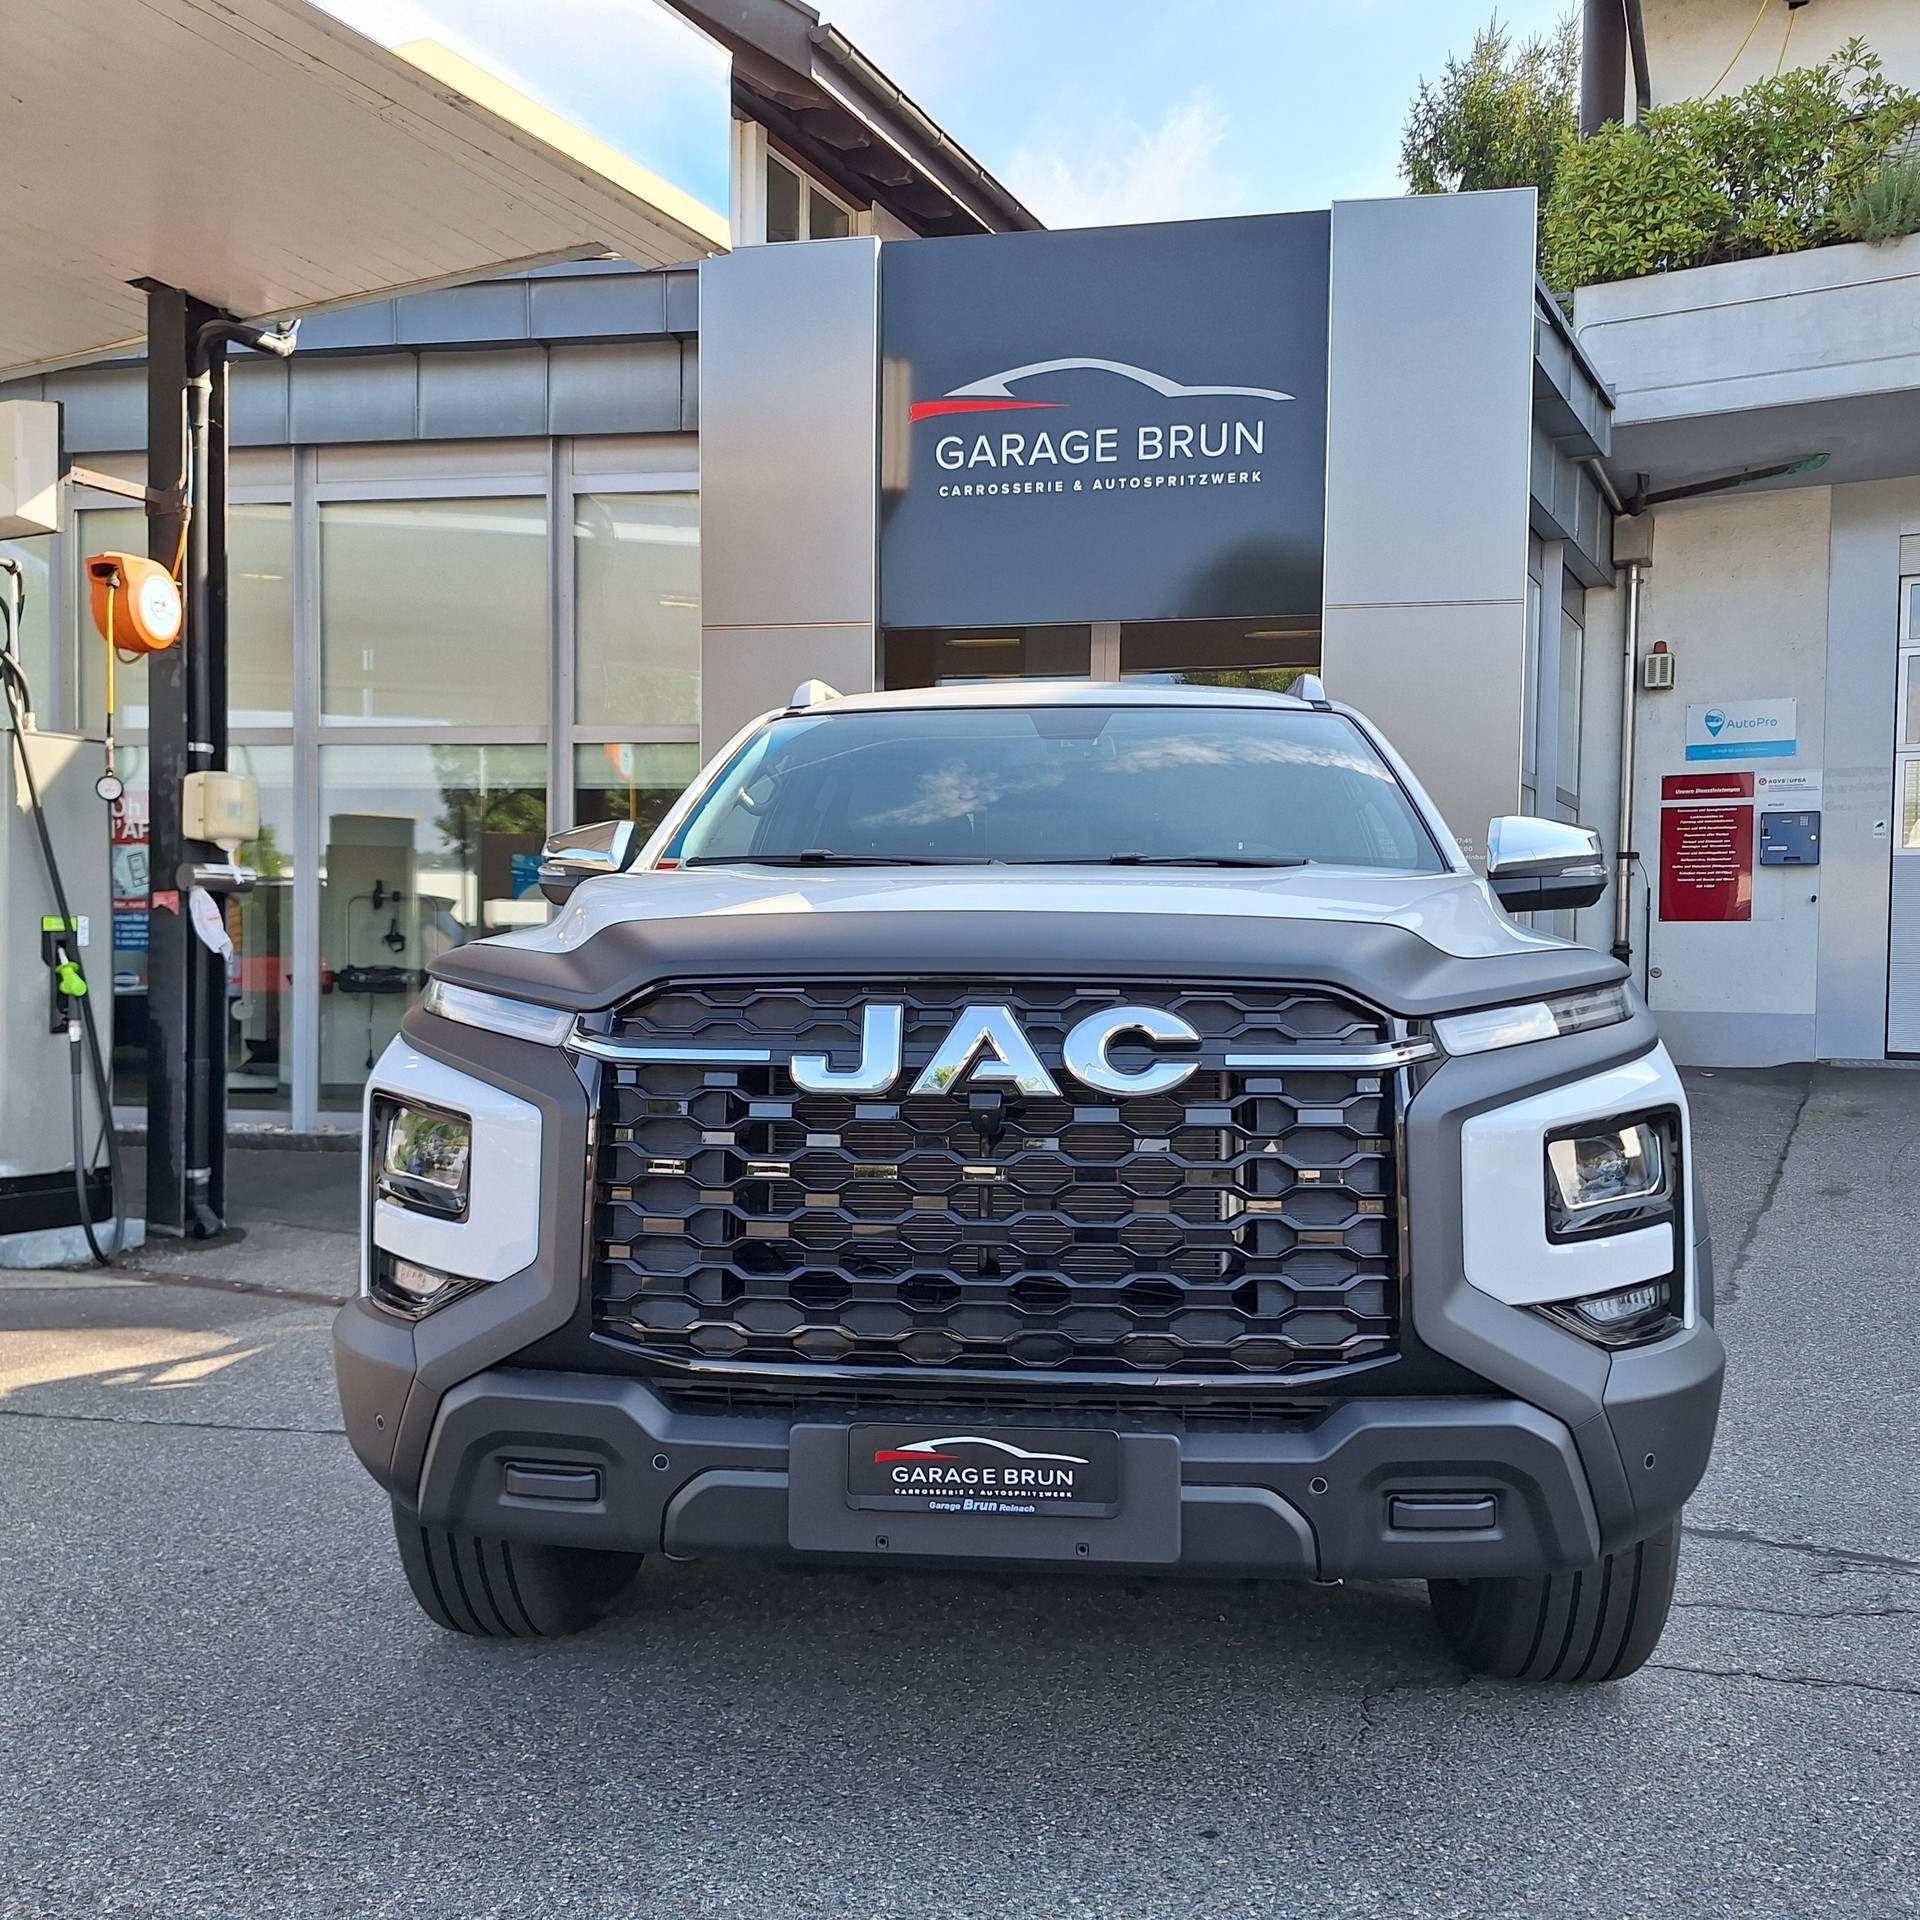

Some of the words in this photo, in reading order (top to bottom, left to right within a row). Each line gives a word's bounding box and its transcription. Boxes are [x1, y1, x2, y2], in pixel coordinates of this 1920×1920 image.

[935, 428, 1118, 470] GARAGE
[1138, 420, 1264, 460] BRUN
[939, 480, 1063, 497] CARROSSERIE
[1074, 480, 1083, 491] &
[1092, 471, 1262, 491] AUTOSPRITZWERK
[1726, 717, 1777, 729] AutoPro
[789, 1003, 1202, 1099] JAC
[891, 1466, 997, 1485] GARAGE
[1003, 1468, 1074, 1486] BRUN
[894, 1488, 964, 1497] CARROSSERIE
[979, 1489, 1073, 1499] AUTOSPRITZWERK
[929, 1501, 962, 1513] Garage
[962, 1499, 998, 1513] Brun
[999, 1503, 1036, 1514] Reinach
